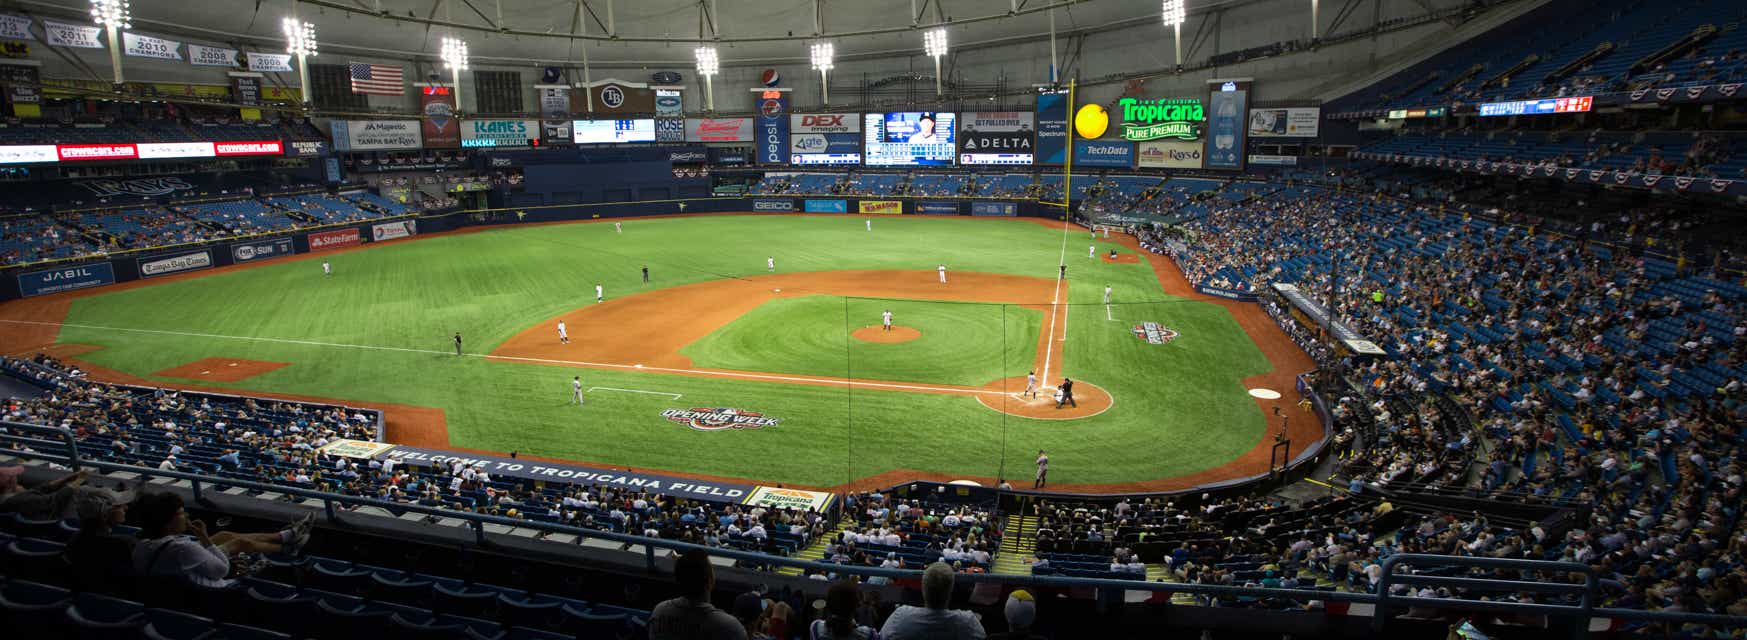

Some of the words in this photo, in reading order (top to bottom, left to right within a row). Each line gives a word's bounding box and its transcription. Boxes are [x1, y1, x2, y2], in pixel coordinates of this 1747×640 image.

[60, 30, 88, 41] 2011
[137, 41, 167, 52] 2010
[129, 48, 175, 59] CHAMPIONS
[200, 51, 226, 60] 2008
[193, 58, 234, 66] CHAMPIONS
[1119, 98, 1204, 124] Tropicana
[657, 118, 683, 130] ROSE
[801, 115, 845, 127] DEX
[1038, 130, 1066, 138] Spectrum
[1126, 127, 1148, 139] PURE
[1150, 124, 1191, 137] PREMIUM
[765, 121, 780, 162] pepsi
[981, 138, 1030, 148] DELTA
[755, 201, 792, 209] GEICO
[145, 261, 170, 273] Tampa
[171, 259, 186, 270] Bay
[185, 256, 207, 267] Times
[43, 268, 92, 282] JABIL
[660, 408, 731, 422] OPENING
[733, 414, 779, 427] WEEK
[386, 449, 491, 469] WELCOME
[495, 462, 524, 472] TO
[529, 466, 661, 489] TROPICANA
[668, 482, 744, 498] FIELD
[763, 492, 814, 504] Tropicana
